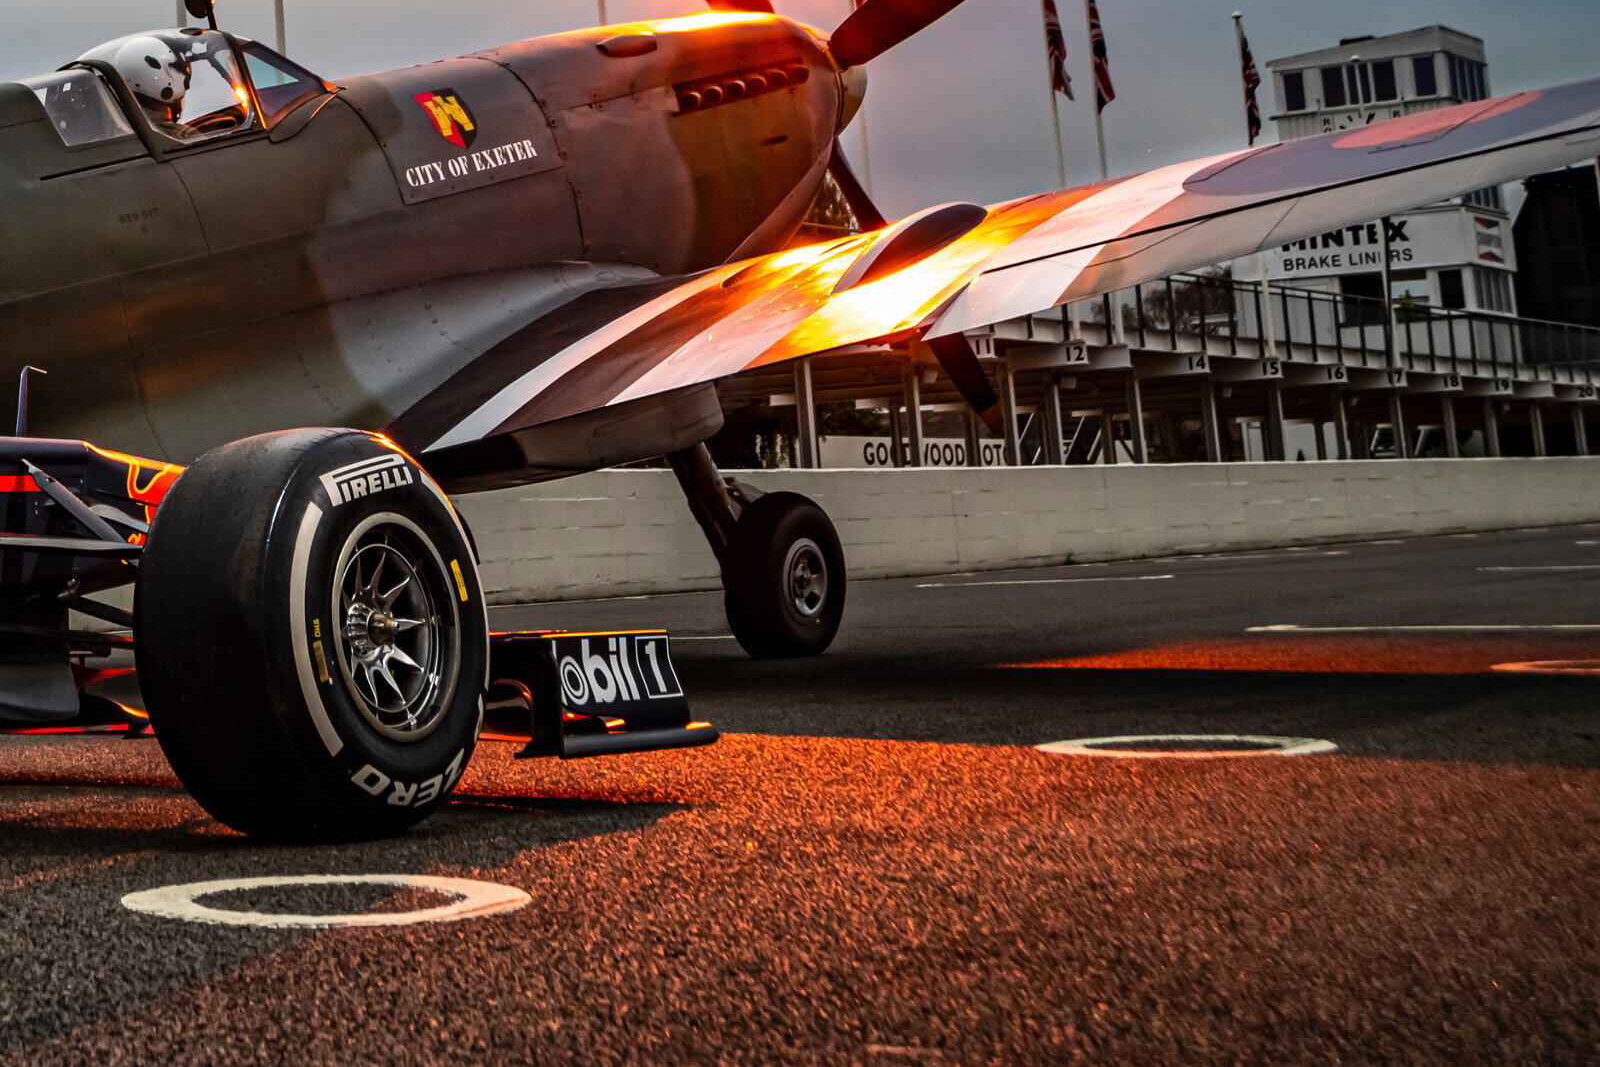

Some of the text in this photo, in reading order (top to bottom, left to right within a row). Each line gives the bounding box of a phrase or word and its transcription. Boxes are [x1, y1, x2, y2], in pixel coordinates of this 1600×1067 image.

[405, 139, 538, 187] CITY OF EXETER
[1283, 247, 1413, 272] BRAKE LINRS
[1066, 346, 1085, 362] 12
[1188, 355, 1206, 370] 14
[1262, 361, 1280, 376] 15
[1326, 366, 1344, 381] 16
[1387, 369, 1403, 384] 17
[1443, 375, 1459, 388] 18
[1495, 379, 1509, 392] 19
[1577, 385, 1594, 398] 20
[863, 442, 965, 466] GOOOD
[319, 453, 414, 507] PIRELLI
[551, 637, 667, 706] obil 1
[351, 748, 465, 807] ZERO
